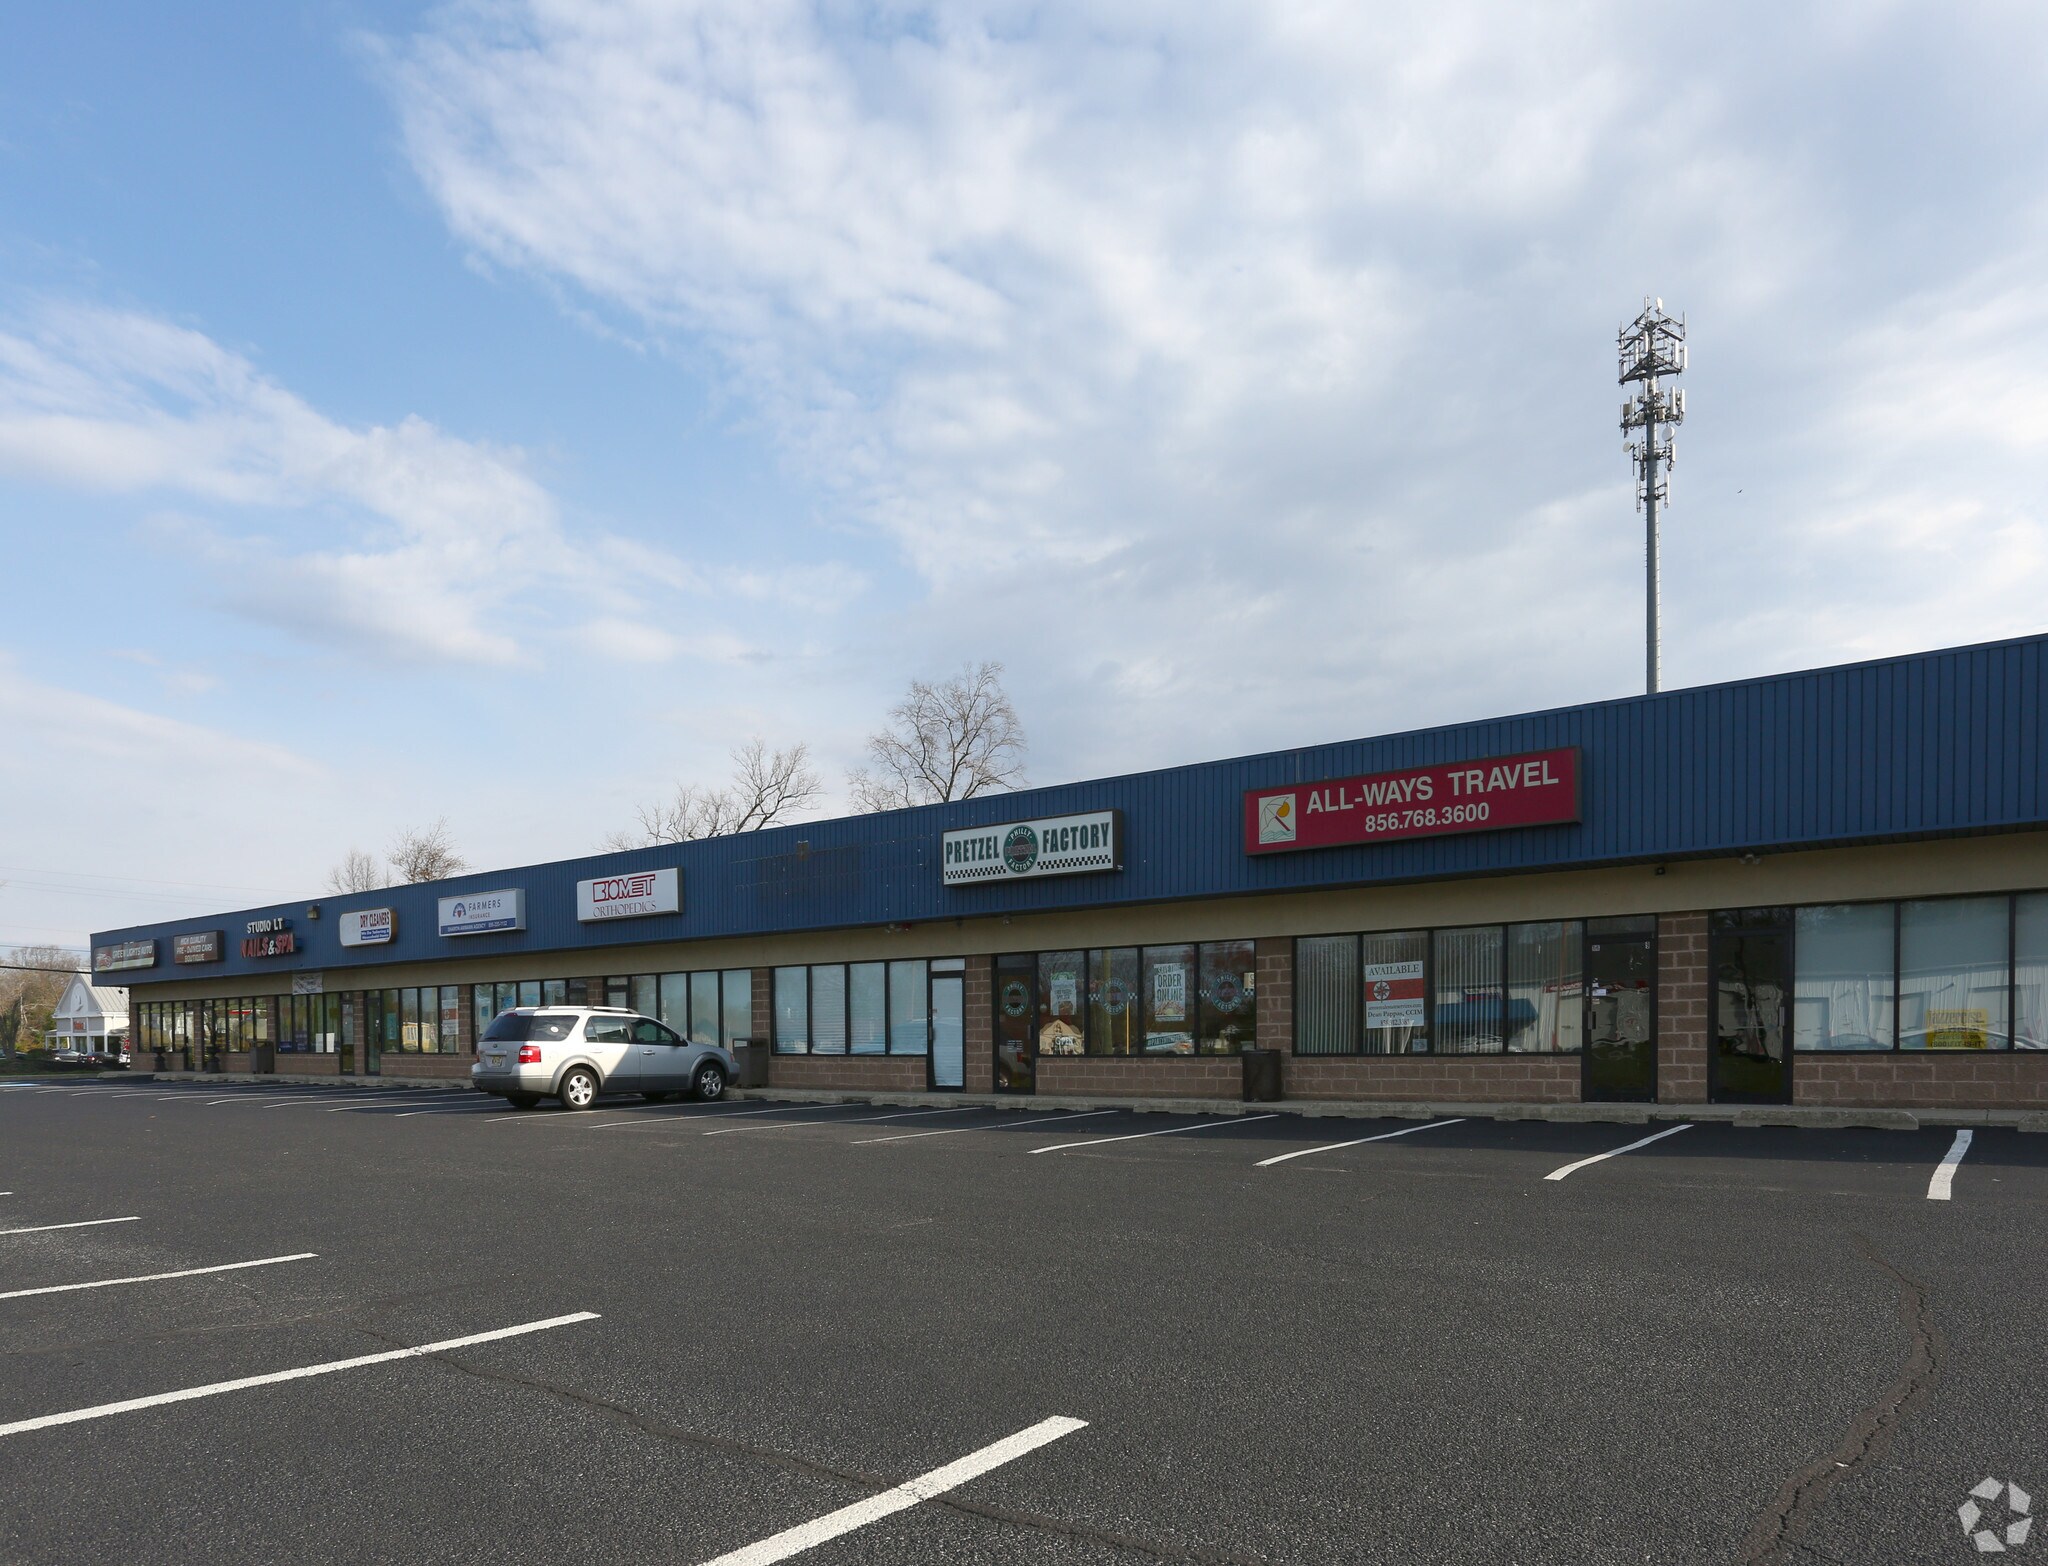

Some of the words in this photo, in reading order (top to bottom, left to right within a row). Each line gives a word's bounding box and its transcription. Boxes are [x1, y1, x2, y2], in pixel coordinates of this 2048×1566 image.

[1306, 776, 1434, 814] ALL-WAYS
[1448, 760, 1559, 796] TRAVEL
[1366, 802, 1490, 833] 856.768.3600
[1010, 827, 1032, 839] PHILLY
[946, 836, 1000, 864] PRETZEL
[1042, 822, 1110, 853] FACTORY
[1008, 857, 1034, 871] FACTORY
[468, 899, 501, 911] FARMERS
[593, 901, 656, 917] ORTHOPEDICS
[247, 919, 271, 933] STUDIO
[273, 917, 283, 930] LT
[360, 914, 368, 928] DRY
[369, 911, 390, 927] CLEANERS
[190, 935, 206, 943] QUALITY
[112, 948, 126, 959] GREEN
[126, 947, 140, 957] LIGHTS
[141, 945, 152, 954] AUTO
[202, 943, 213, 952] CARS
[1369, 964, 1419, 976] AVAILABLE
[1157, 974, 1181, 987] ORDER
[1156, 988, 1183, 1001] ONLINE
[1383, 1010, 1404, 1018] Pappas,
